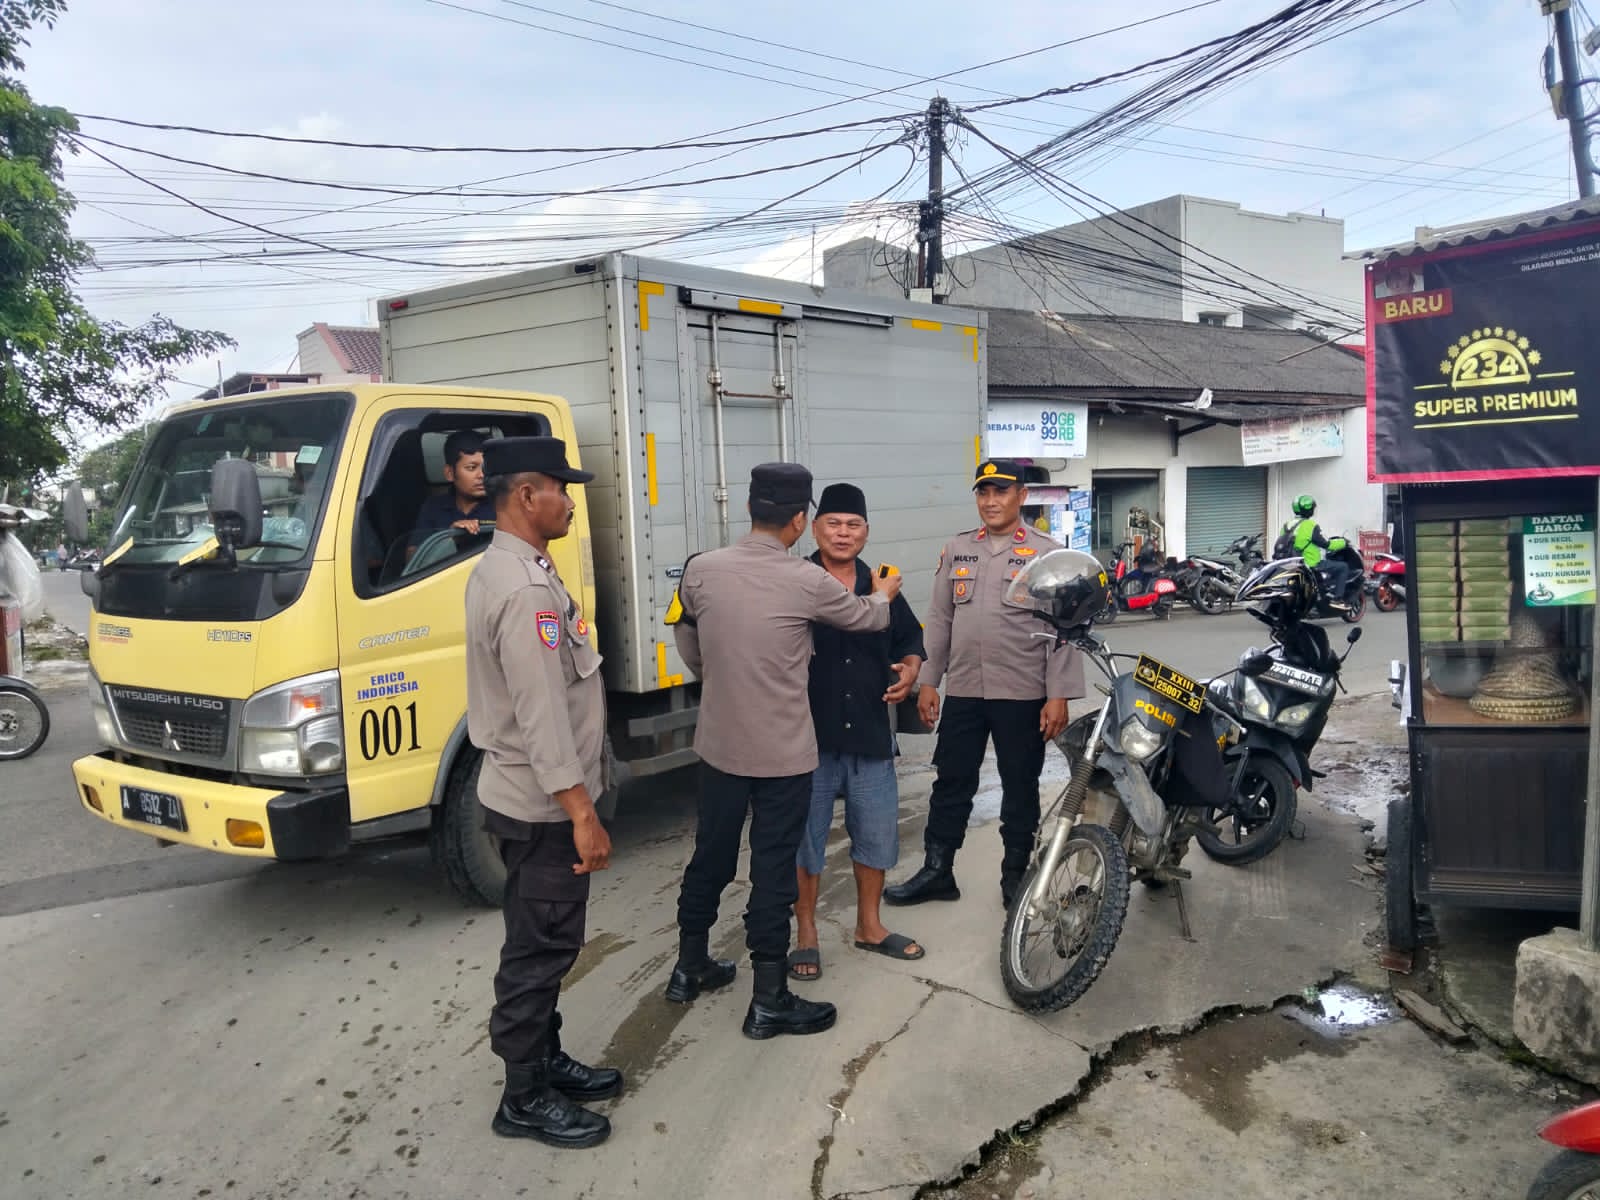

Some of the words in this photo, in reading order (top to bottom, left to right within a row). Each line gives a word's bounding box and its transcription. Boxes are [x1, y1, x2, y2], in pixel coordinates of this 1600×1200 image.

[1384, 293, 1443, 319] BARU
[1460, 350, 1519, 380] 234
[1414, 396, 1478, 418] SUPER
[1482, 388, 1578, 413] PREMIUM
[1532, 514, 1585, 525] DAFTAR
[1535, 523, 1582, 533] HARGA
[953, 555, 979, 563] MULYO
[359, 625, 430, 649] CANTER
[370, 671, 405, 686] ERICO
[1170, 671, 1195, 692] XXIII
[113, 689, 181, 705] MITSUBISHI
[184, 697, 224, 710] FUSO
[357, 681, 419, 700] INDONESIA
[1156, 680, 1182, 699] 25007
[1135, 699, 1176, 728] POLISI
[360, 700, 422, 761] 001
[123, 788, 130, 809] A
